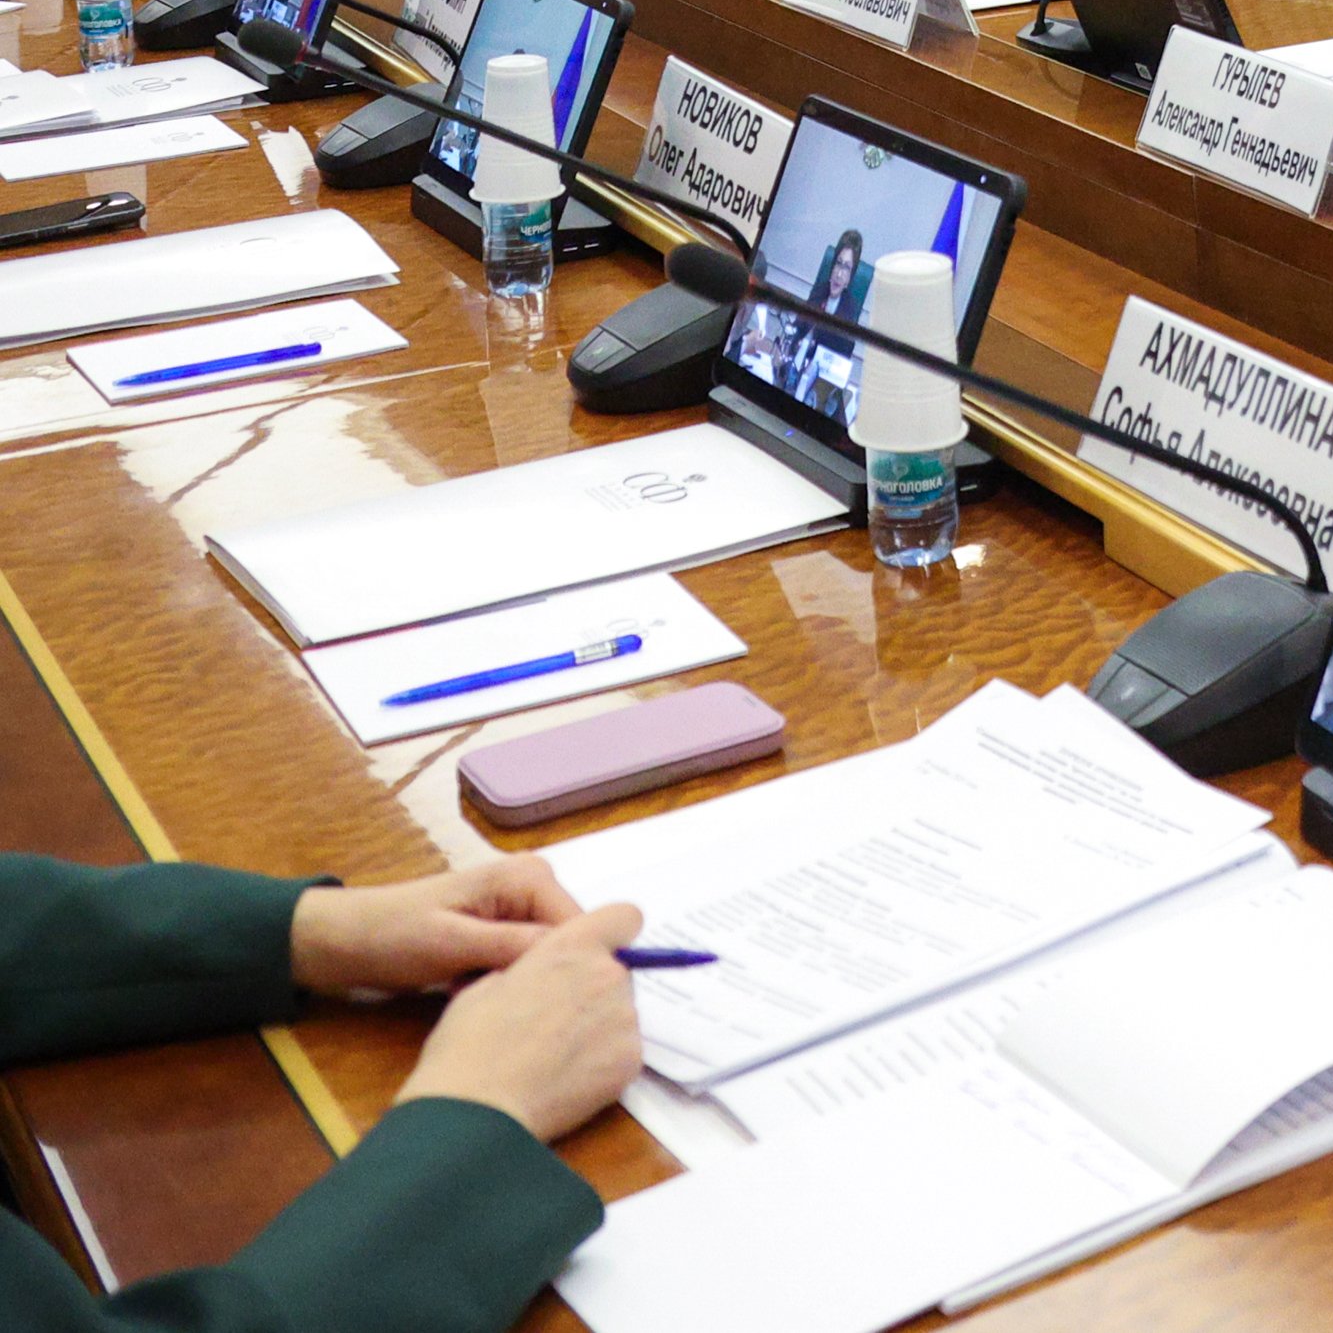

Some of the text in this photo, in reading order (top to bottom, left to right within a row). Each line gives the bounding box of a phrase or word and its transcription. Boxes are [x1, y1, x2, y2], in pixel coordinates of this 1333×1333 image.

[677, 78, 764, 156] НОВИКОВ
[1212, 52, 1287, 110] ГУРЫЛЕВ
[648, 124, 769, 229] Олег Адарович
[1151, 89, 1319, 188] Александр Геннадьевич
